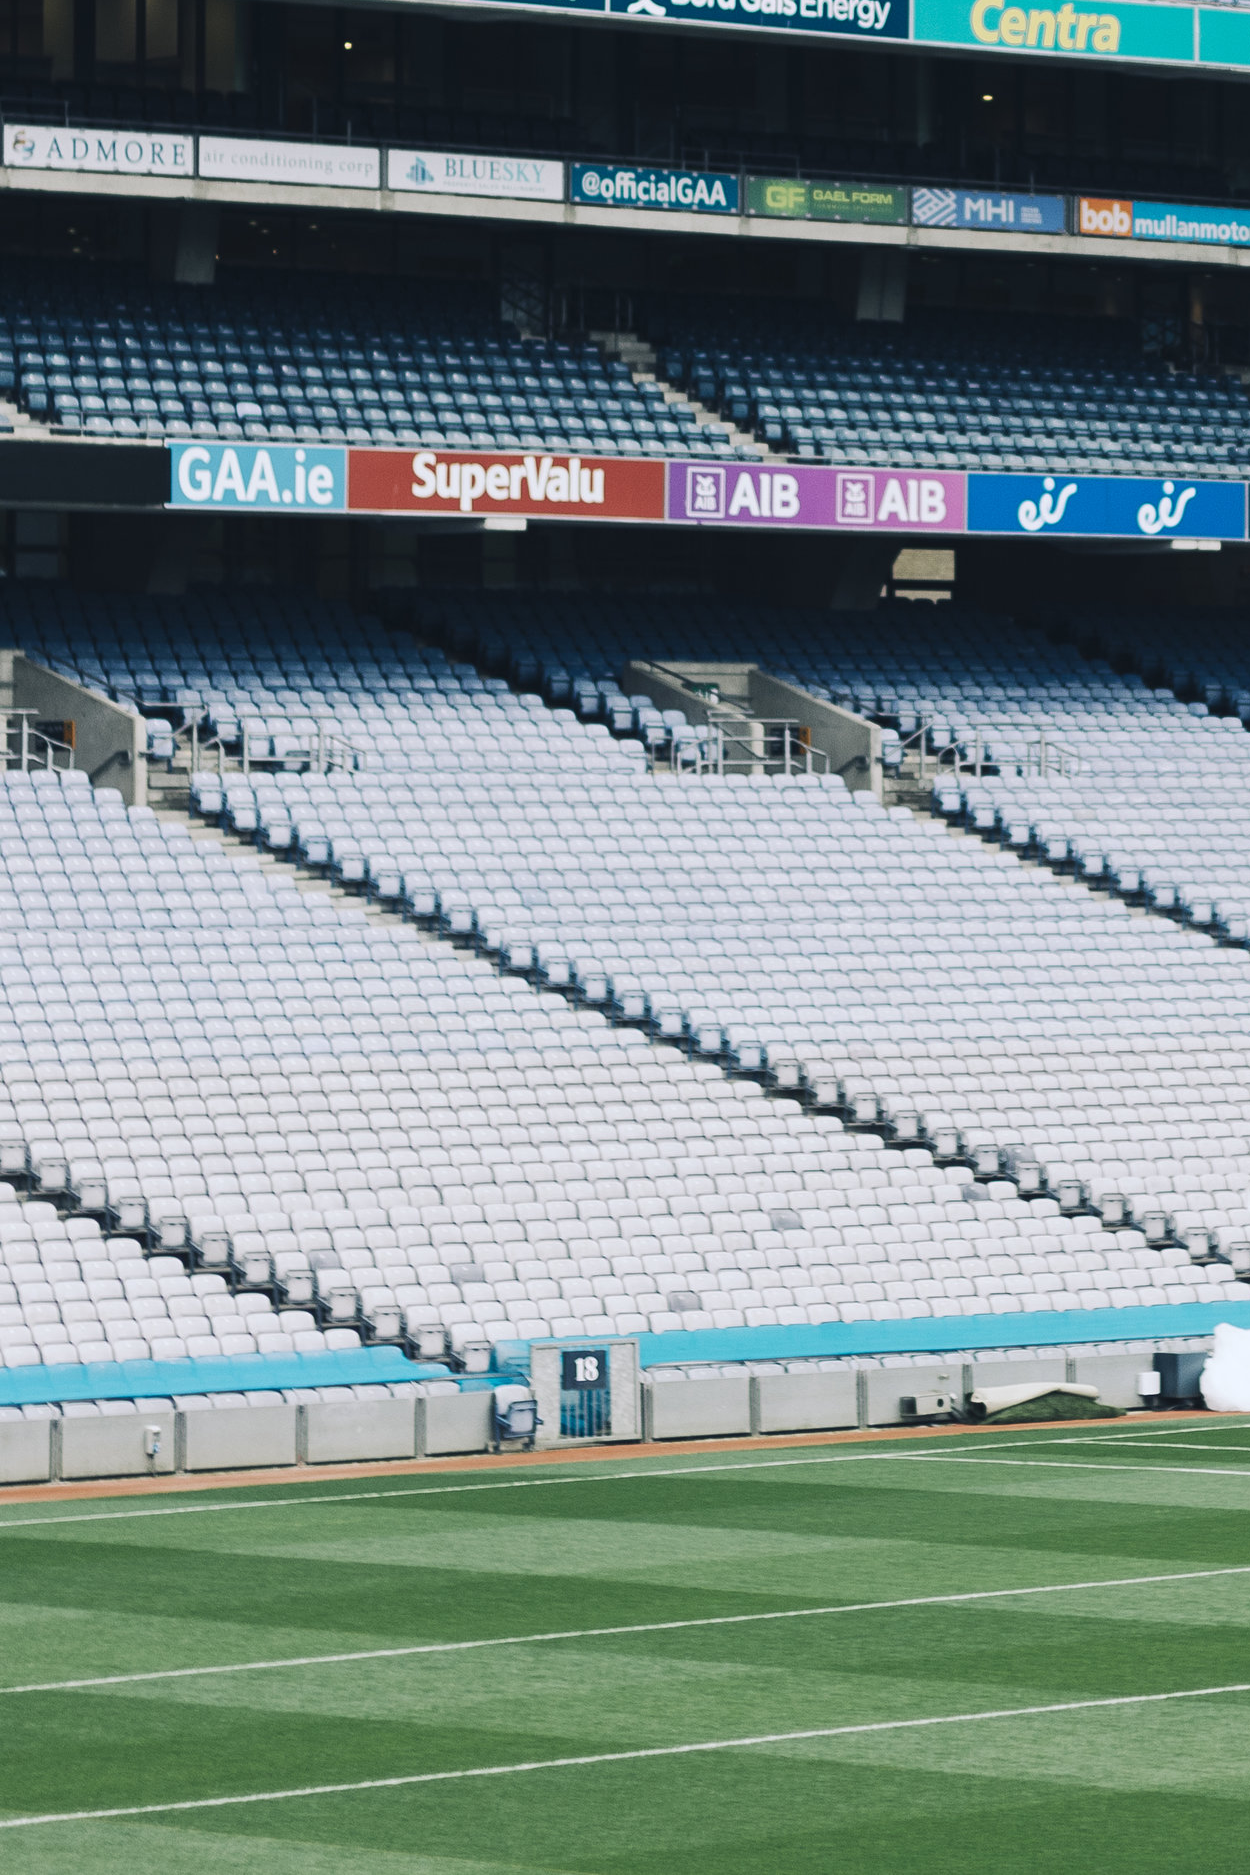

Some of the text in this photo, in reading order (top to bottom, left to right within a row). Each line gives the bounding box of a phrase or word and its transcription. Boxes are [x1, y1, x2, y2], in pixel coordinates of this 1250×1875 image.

[46, 136, 186, 167] ADMORE
[204, 149, 374, 177] air conditioning corp
[445, 158, 546, 183] BLUESKY
[582, 171, 728, 208] @officialGAA
[766, 185, 806, 208] GF
[813, 189, 893, 205] GAEL FORM
[963, 198, 1015, 224] MHI
[1081, 201, 1130, 233] bob
[178, 446, 334, 505] GAA.ie
[411, 452, 605, 512] SuperValu
[728, 472, 800, 518] AIB
[877, 478, 947, 523] AIB
[1018, 476, 1078, 532] eir
[1137, 480, 1197, 535] eir
[574, 1356, 599, 1383] 18
